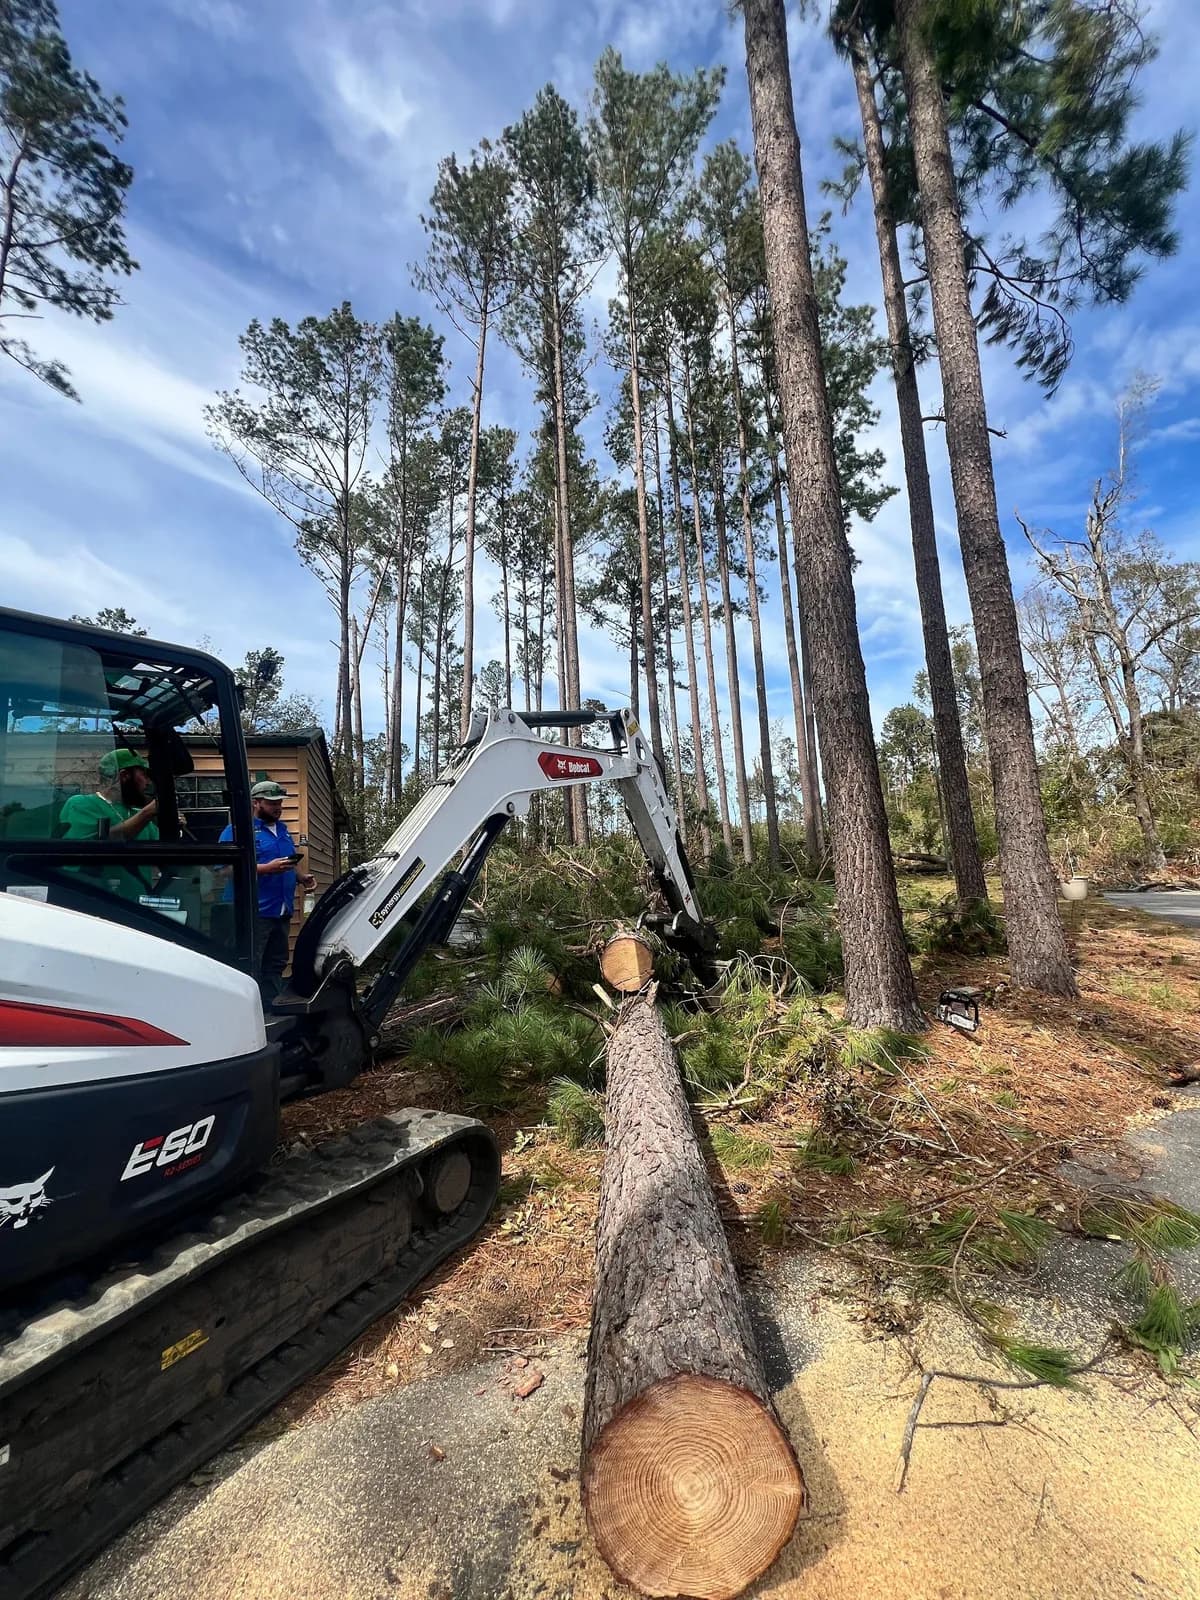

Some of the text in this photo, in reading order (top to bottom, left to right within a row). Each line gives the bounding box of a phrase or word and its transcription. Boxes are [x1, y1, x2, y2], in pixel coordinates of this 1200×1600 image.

[568, 761, 590, 774] Bobcat
[380, 889, 401, 916] synergy
[120, 1114, 216, 1181] E60
